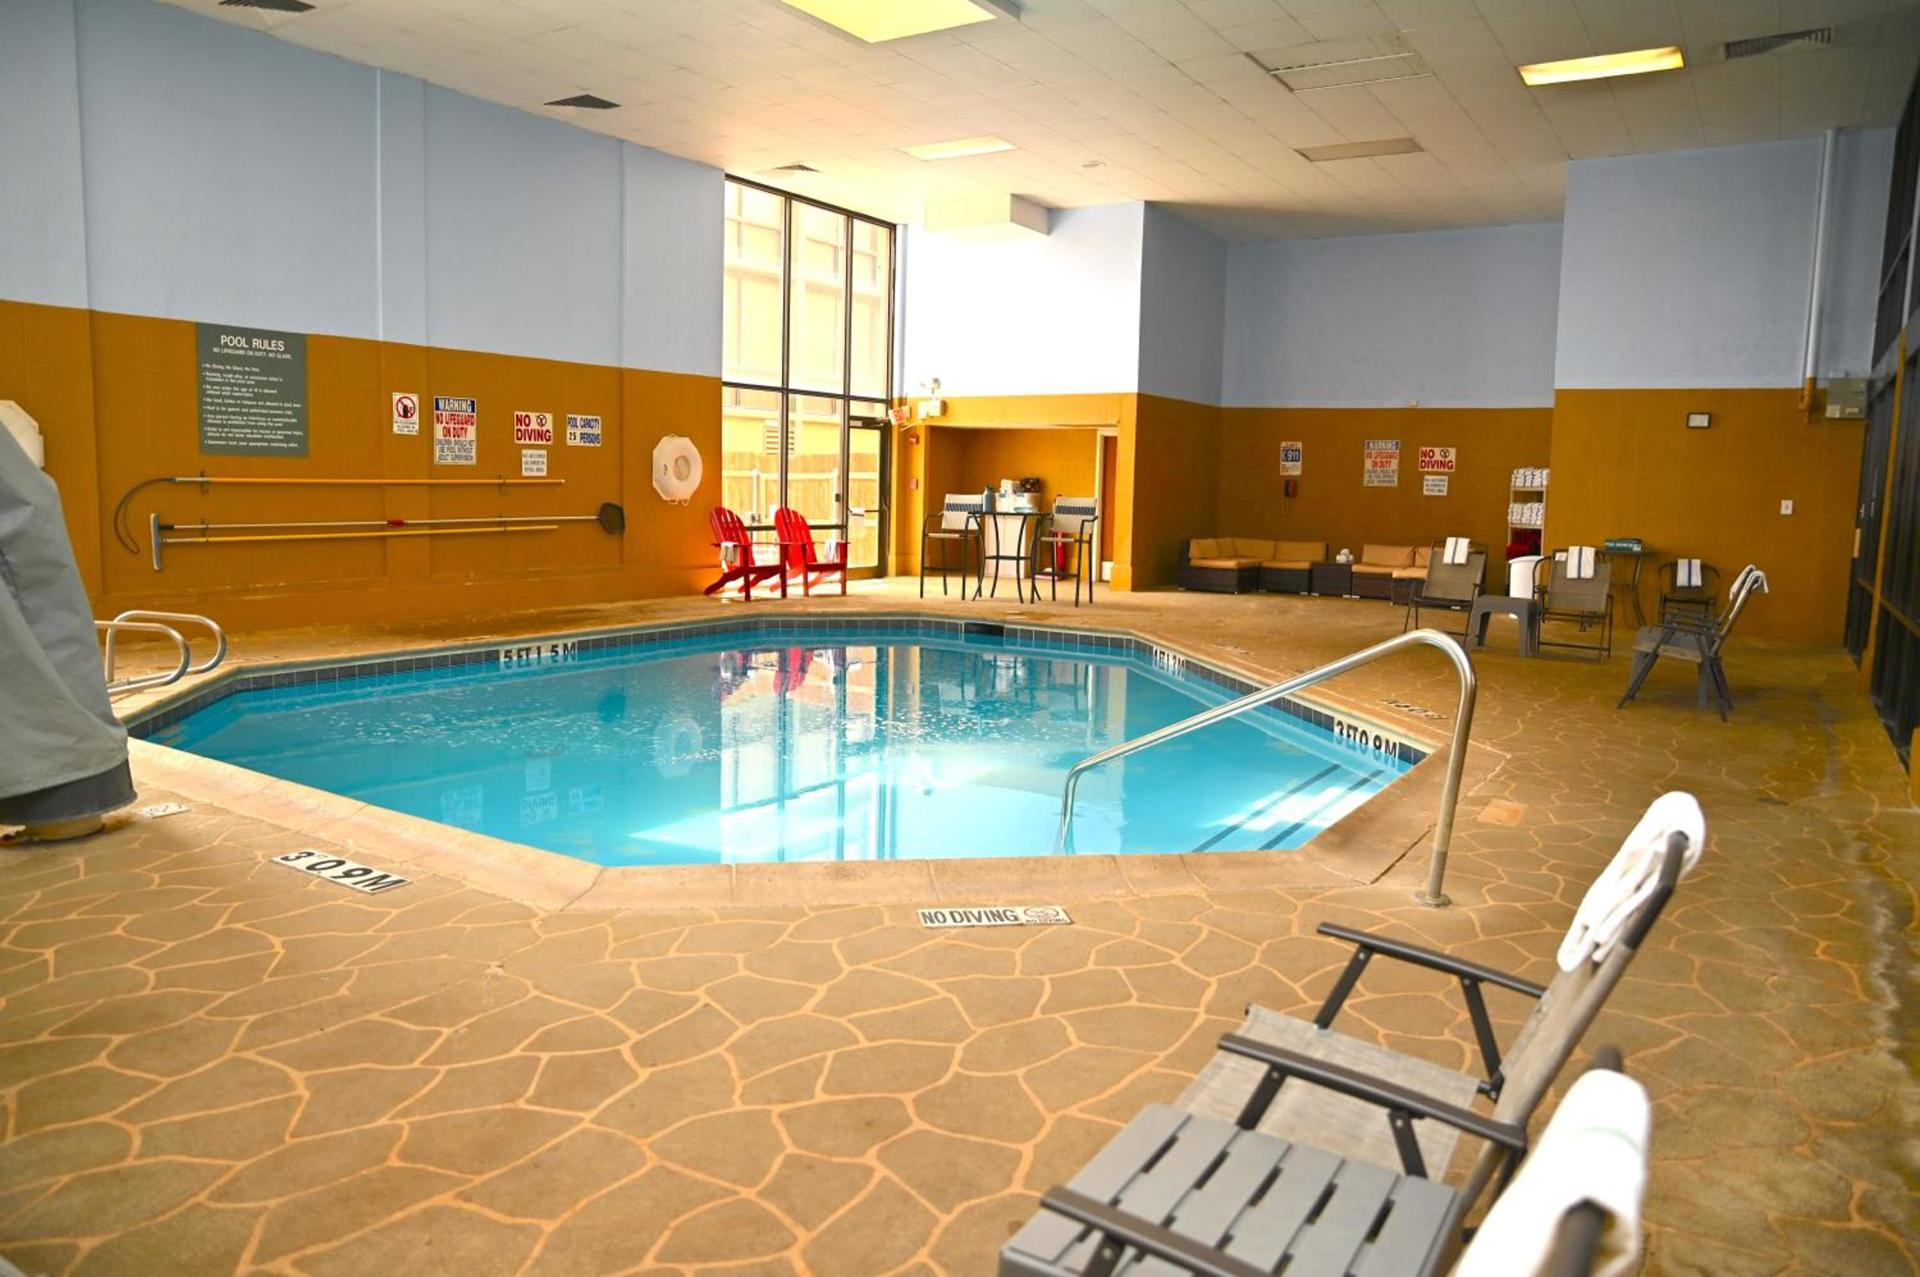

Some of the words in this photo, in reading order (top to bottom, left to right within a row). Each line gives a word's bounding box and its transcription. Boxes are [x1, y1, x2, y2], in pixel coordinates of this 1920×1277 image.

[220, 334, 249, 348] POOL
[252, 338, 285, 351] RULES
[222, 347, 246, 356] LIFEGUARD
[438, 398, 472, 413] WARNING
[435, 413, 444, 425] NO
[445, 413, 475, 426] LIFEGUARD
[516, 414, 531, 427] NO
[442, 425, 452, 438] ON
[452, 426, 468, 438] DUTY
[516, 428, 551, 442] DIVING
[1287, 450, 1299, 461] 911
[1420, 450, 1435, 459] NO
[1420, 459, 1454, 470] DIVING
[921, 911, 947, 924] NO
[950, 910, 1019, 924] DIVING
